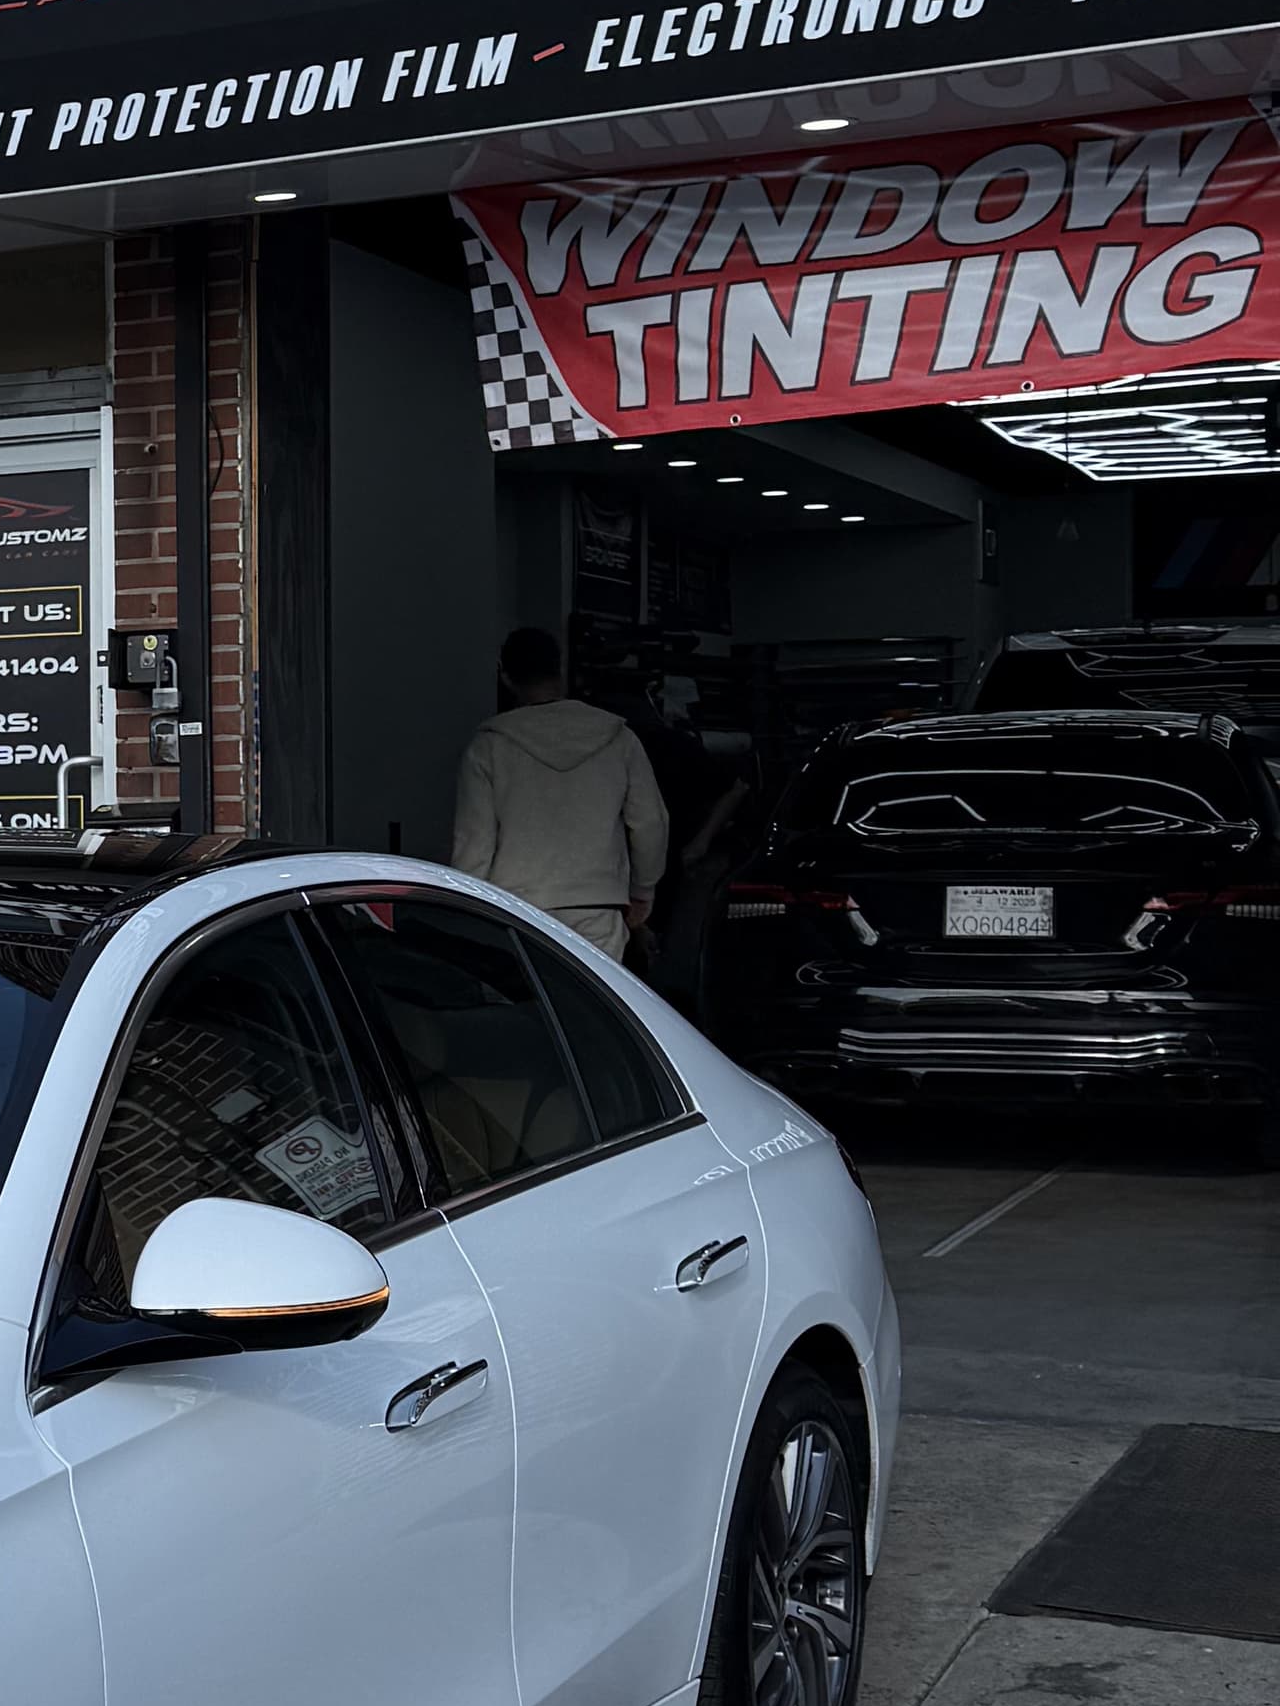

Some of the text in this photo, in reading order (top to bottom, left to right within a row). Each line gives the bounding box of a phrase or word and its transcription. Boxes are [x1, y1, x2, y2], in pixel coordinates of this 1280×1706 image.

[48, 58, 364, 151] PROTECTION
[381, 33, 518, 103] FILM
[519, 114, 1244, 296] WINDOW
[584, 224, 1264, 412] TINTING
[24, 603, 71, 622] US:
